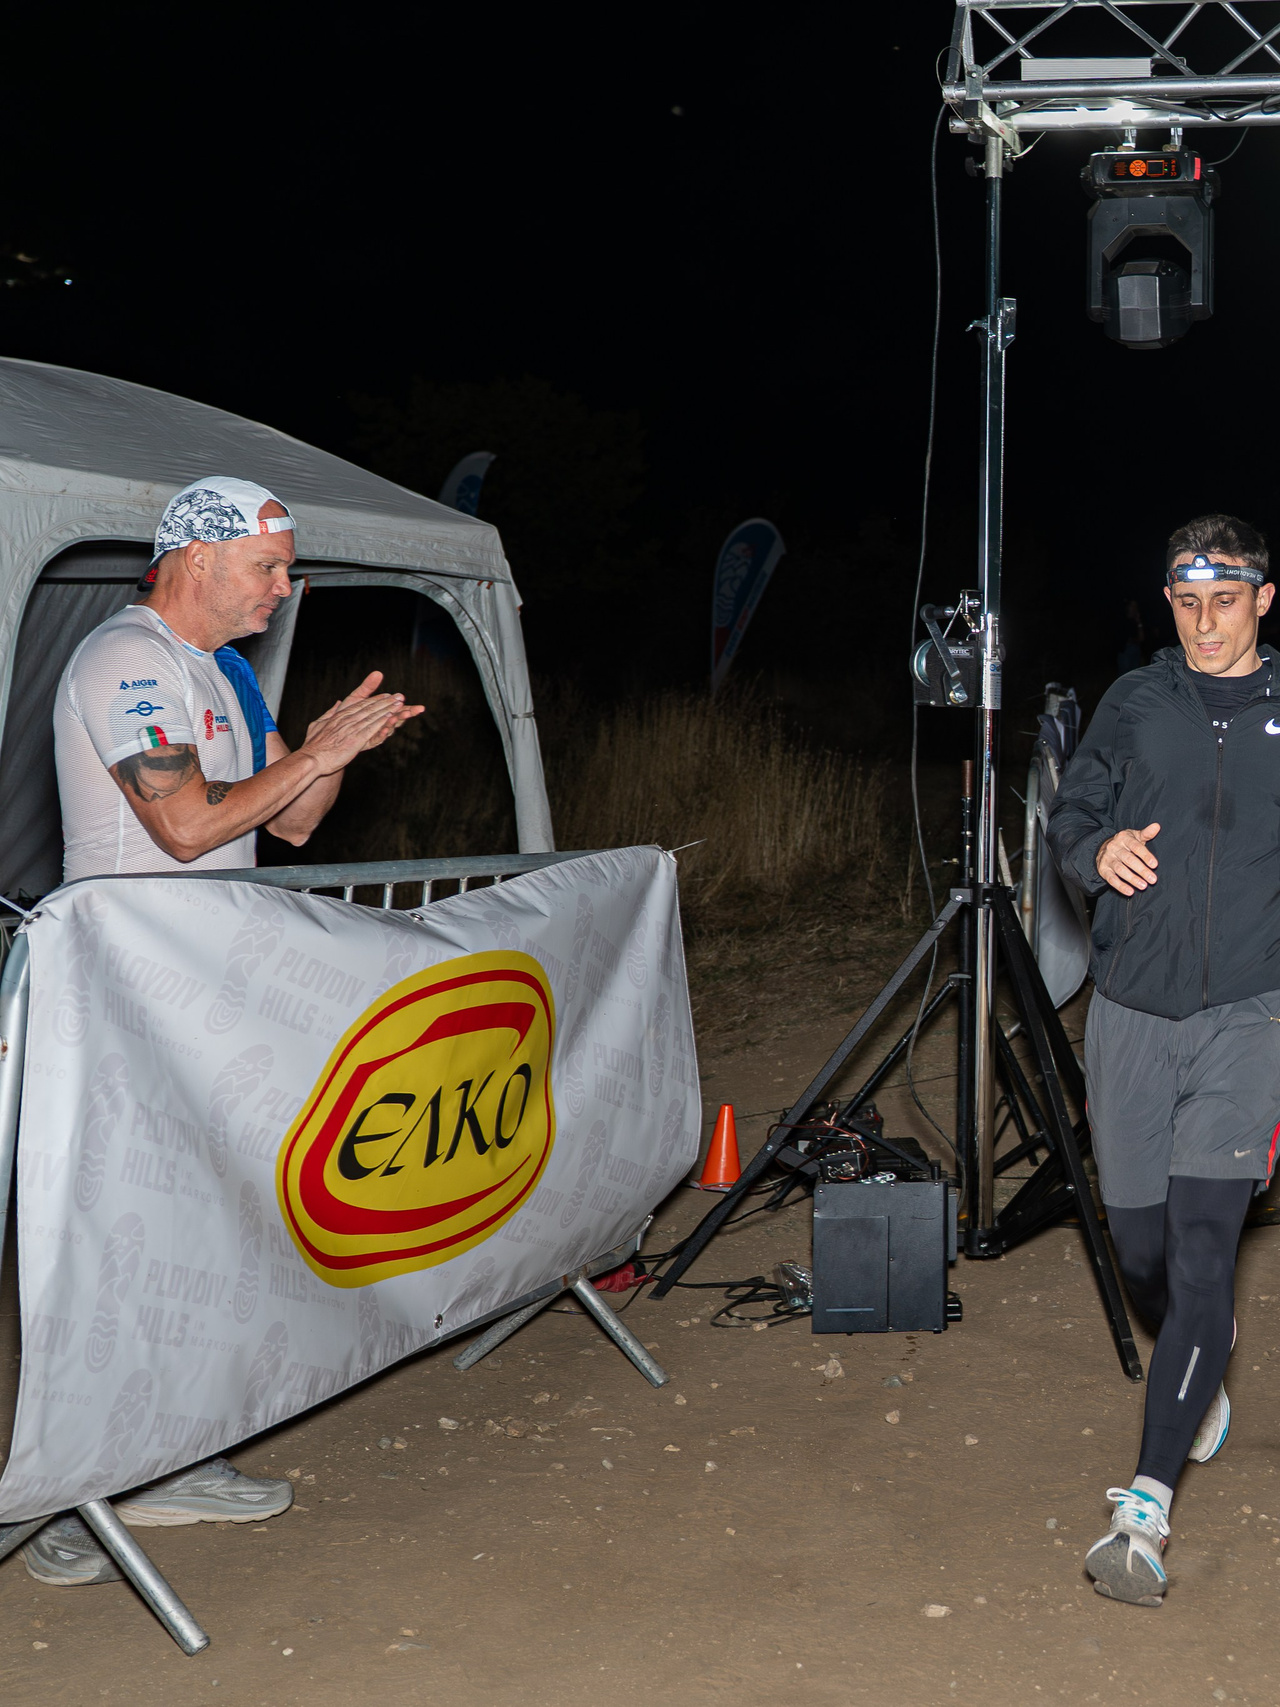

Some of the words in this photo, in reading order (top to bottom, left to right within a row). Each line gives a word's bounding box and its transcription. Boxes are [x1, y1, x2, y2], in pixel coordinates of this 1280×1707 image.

[131, 679, 158, 688] AIGER
[105, 942, 207, 1011] PLOVDIV
[273, 946, 367, 1008] PLOVDIV
[103, 986, 148, 1041] HILLS
[257, 984, 319, 1035] HILLS
[592, 1041, 645, 1083] PLOVDIV
[594, 1072, 626, 1109] HILLS
[129, 1100, 201, 1159] PLOVDIV
[119, 1146, 178, 1196] HILLS
[142, 1258, 228, 1310] PLOVDIV
[268, 1262, 308, 1304] HILLS
[131, 1303, 190, 1349] HILLS
